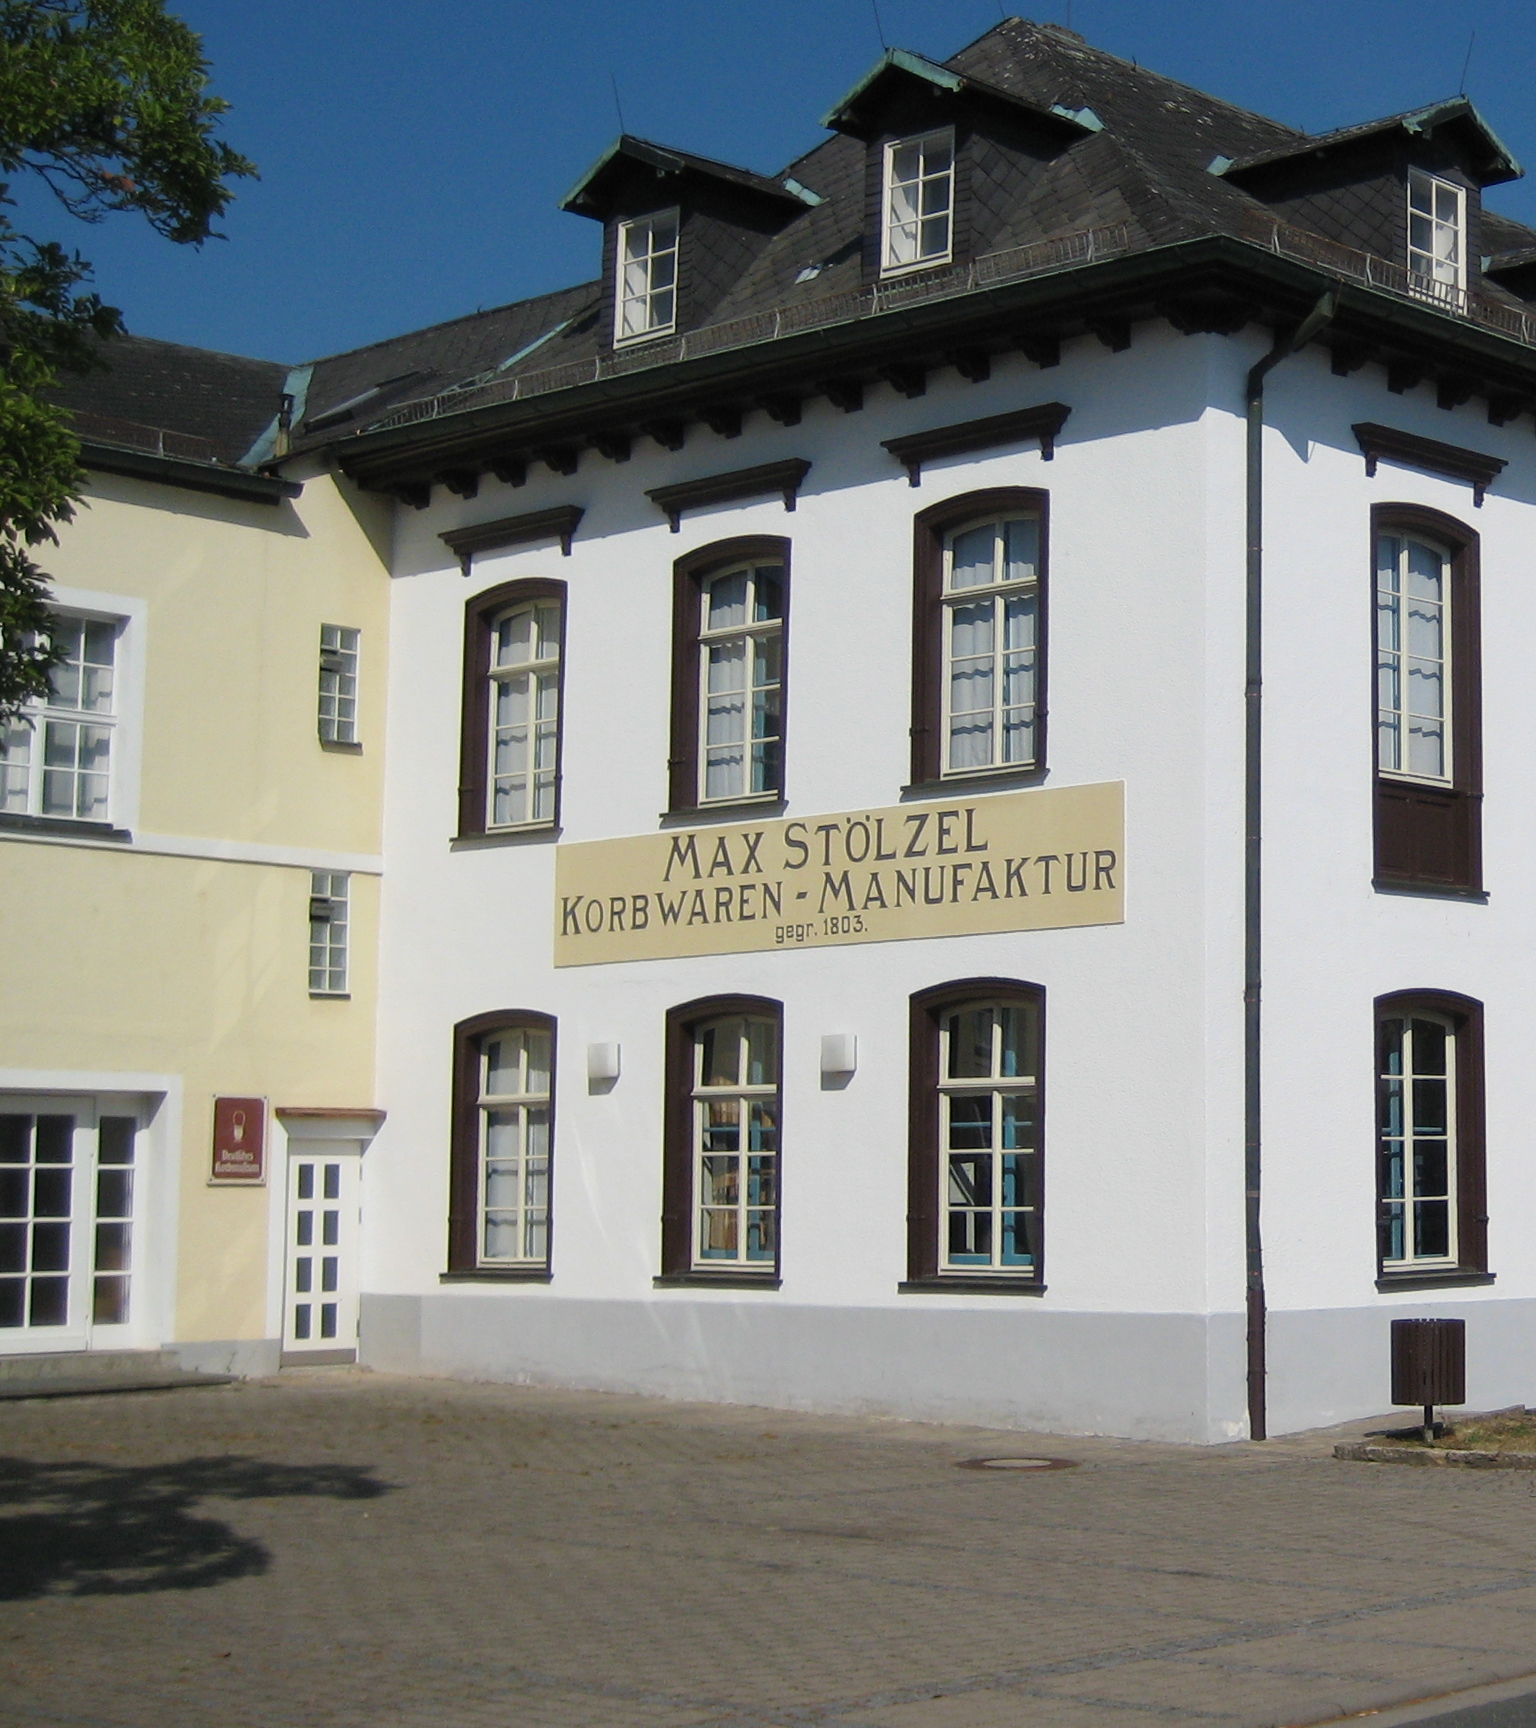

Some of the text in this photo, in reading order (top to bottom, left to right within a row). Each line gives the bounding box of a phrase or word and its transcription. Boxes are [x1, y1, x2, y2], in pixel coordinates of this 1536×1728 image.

[661, 806, 990, 882] MAX STÖLZEL
[774, 915, 869, 945] gegr. 1803.
